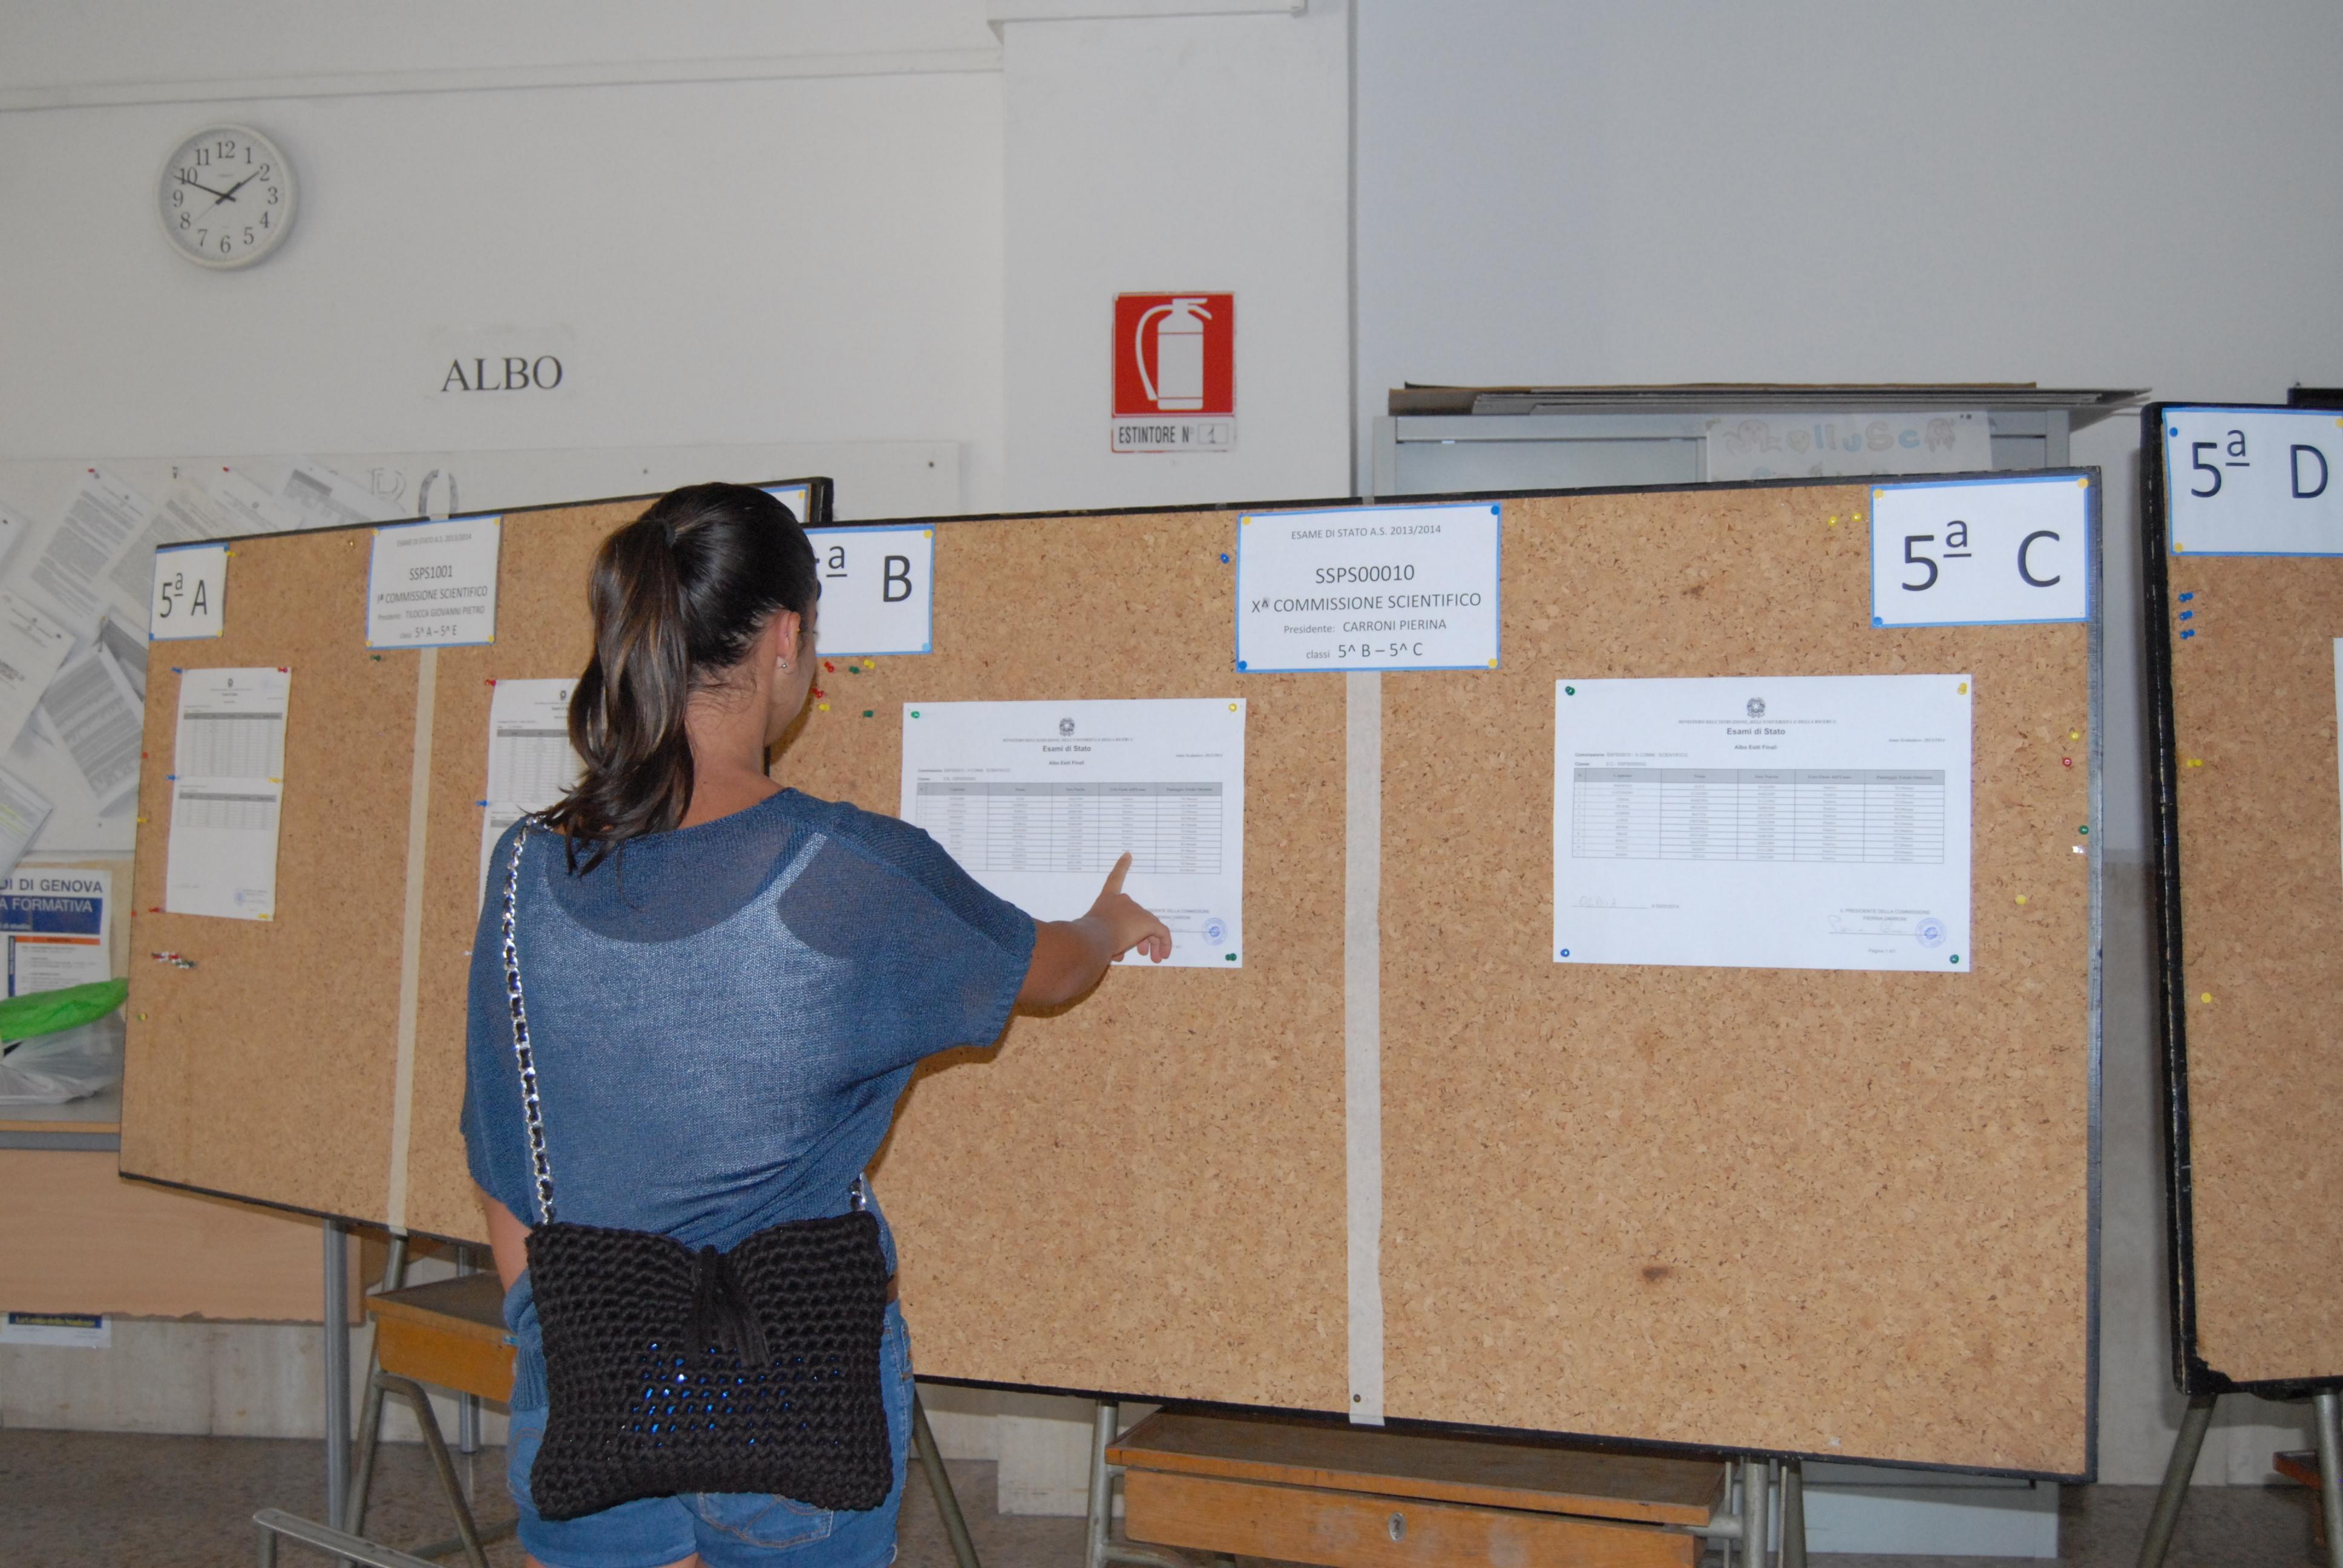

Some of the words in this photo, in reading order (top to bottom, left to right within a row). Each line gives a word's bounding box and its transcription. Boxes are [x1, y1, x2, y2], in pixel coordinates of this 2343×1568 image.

[195, 148, 210, 166] 11
[216, 140, 235, 159] 12
[245, 146, 253, 164] 1
[179, 167, 198, 185] 10
[260, 163, 270, 181] 2
[173, 189, 183, 207] 9
[267, 186, 278, 204] 3
[180, 212, 191, 230] 8
[259, 212, 269, 228] 4
[197, 229, 208, 247] 7
[220, 235, 231, 253] 6
[243, 227, 254, 244] 5
[440, 354, 563, 392] ALBO
[1119, 426, 1176, 443] ESTINTORE
[2290, 444, 2328, 498] D
[1291, 529, 1323, 540] ESAME
[1326, 528, 1335, 538] DI
[1337, 527, 1368, 538] STATO
[1370, 526, 1388, 536] A.S.
[1391, 524, 1441, 536] 2013/2014
[2017, 530, 2060, 587] C
[409, 565, 453, 581] SSPS1001
[883, 555, 912, 603] B
[1315, 564, 1415, 584] SSPS00010
[191, 580, 207, 616] A
[385, 589, 438, 604] COMMISSIONE
[440, 586, 488, 599] SCIENTIFICO
[1274, 595, 1383, 612] COMMISSIONE
[1388, 592, 1481, 609] SCIENTIFICO
[462, 606, 485, 615] PIETRO
[426, 627, 433, 636] A
[452, 625, 457, 635] E
[1283, 624, 1335, 634] Presidente:
[1343, 620, 1396, 633] CARRONI
[1400, 619, 1447, 630] PIERINA
[1306, 650, 1331, 659] classi
[1338, 644, 1356, 658] 5^
[1362, 644, 1371, 657] B
[1389, 642, 1408, 657] 5^
[1413, 642, 1423, 656] C
[19, 878, 34, 890] DI
[40, 879, 103, 893] GENOVA
[12, 898, 93, 912] FORMATIVA
